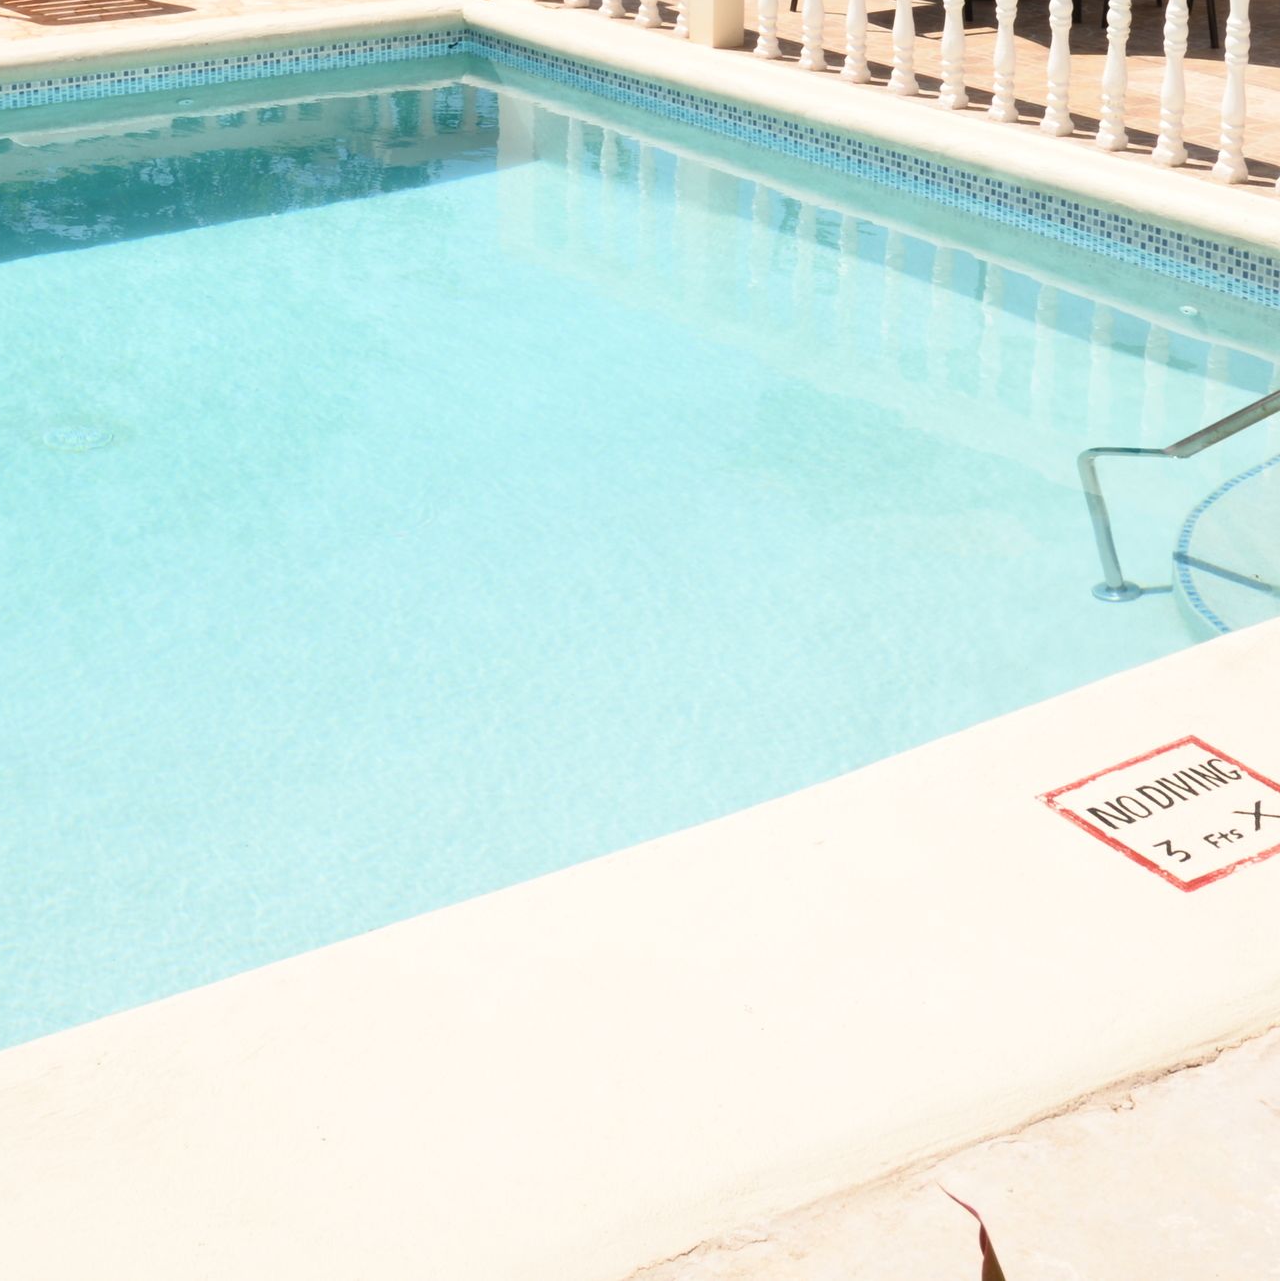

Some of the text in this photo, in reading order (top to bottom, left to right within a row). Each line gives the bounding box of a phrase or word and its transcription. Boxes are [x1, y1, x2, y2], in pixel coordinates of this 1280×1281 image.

[1086, 758, 1243, 830] NO DIVING
[1152, 839, 1192, 863] 3
